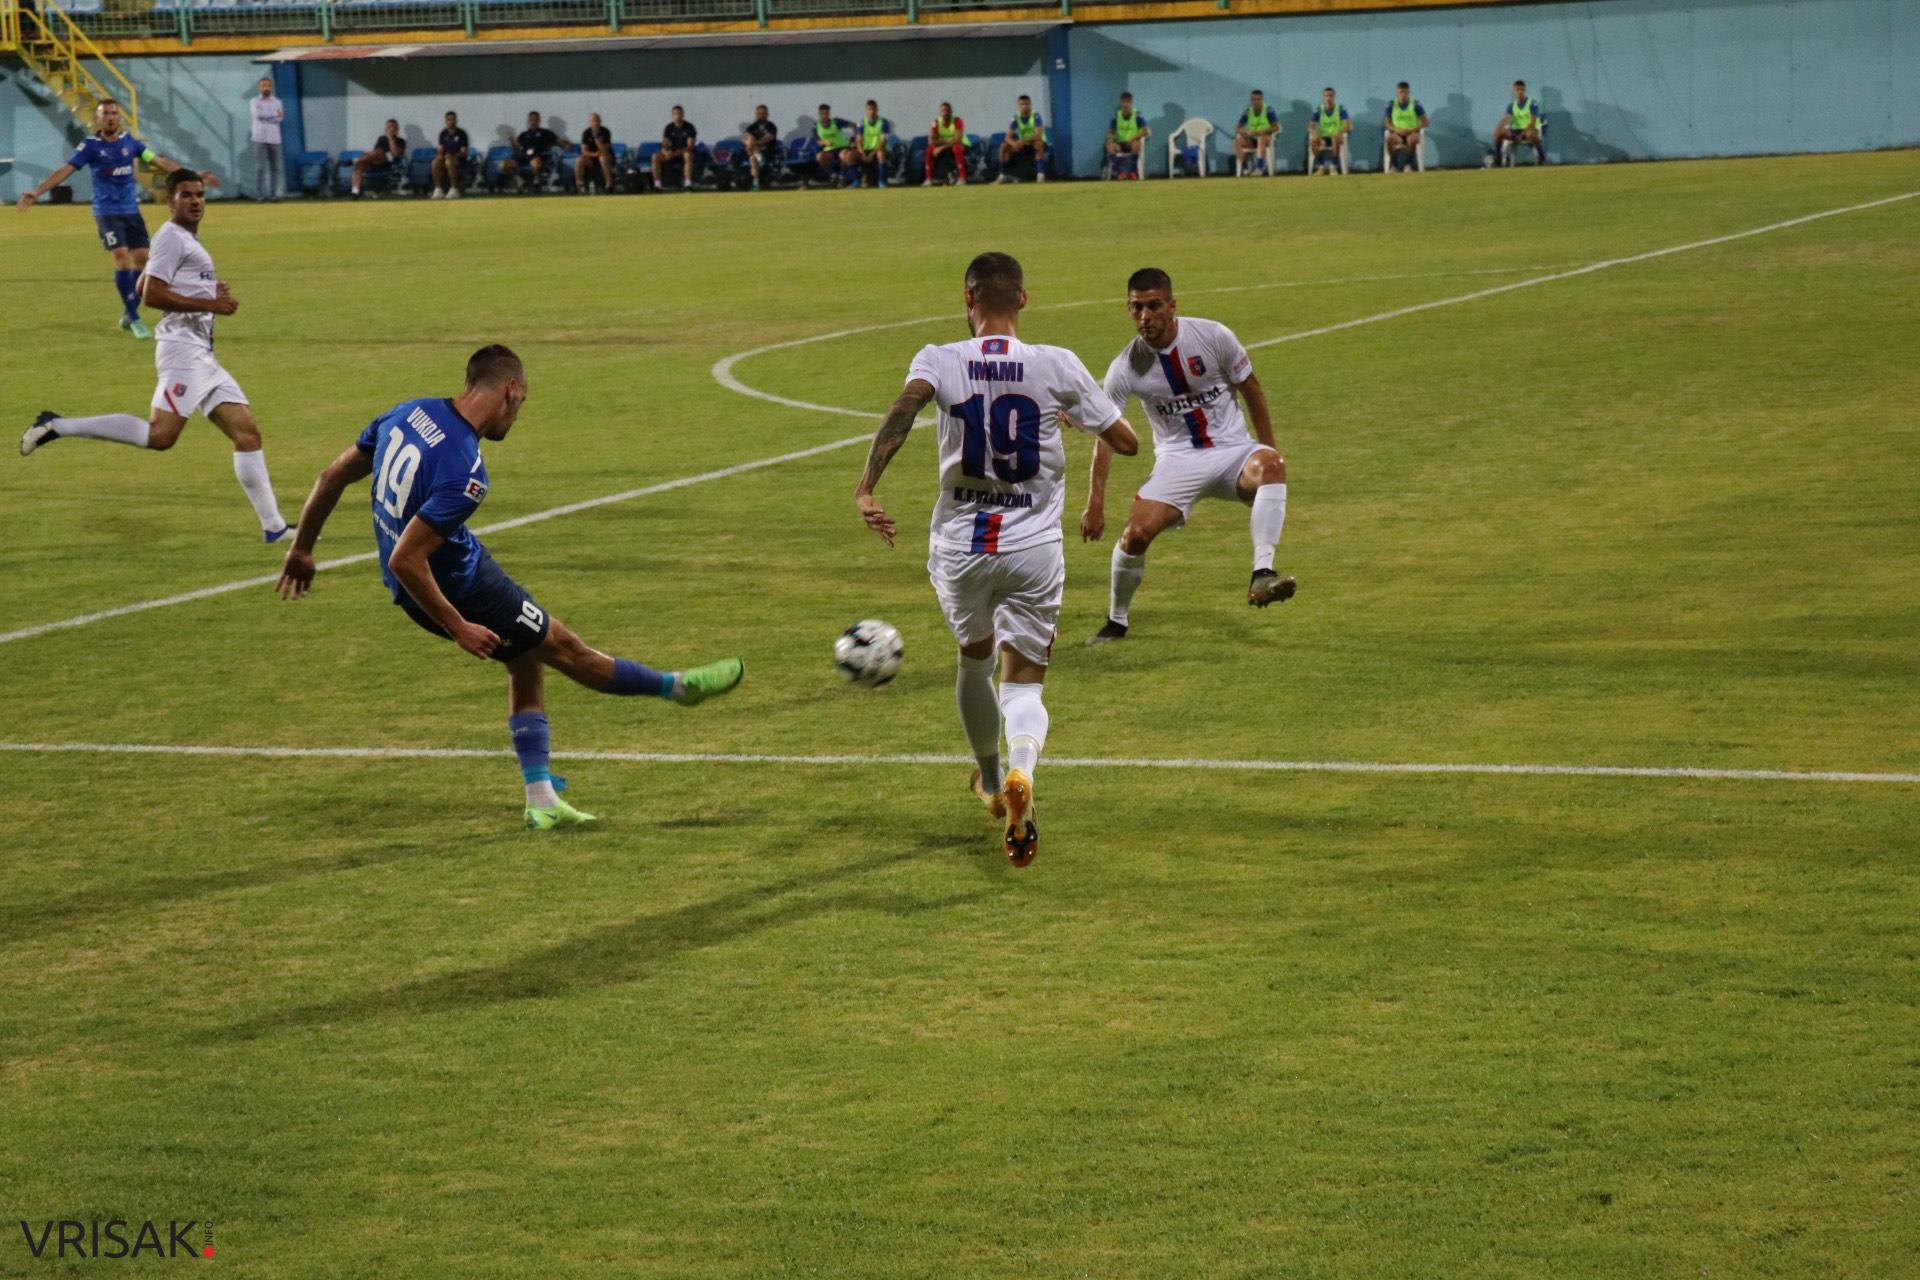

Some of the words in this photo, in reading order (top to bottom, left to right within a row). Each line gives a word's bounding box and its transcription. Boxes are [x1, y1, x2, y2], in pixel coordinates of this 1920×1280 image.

[968, 360, 1024, 383] IMAMI
[406, 406, 447, 448] VUKOJA
[950, 393, 1041, 484] 19
[375, 426, 421, 519] 19
[515, 600, 544, 633] 19
